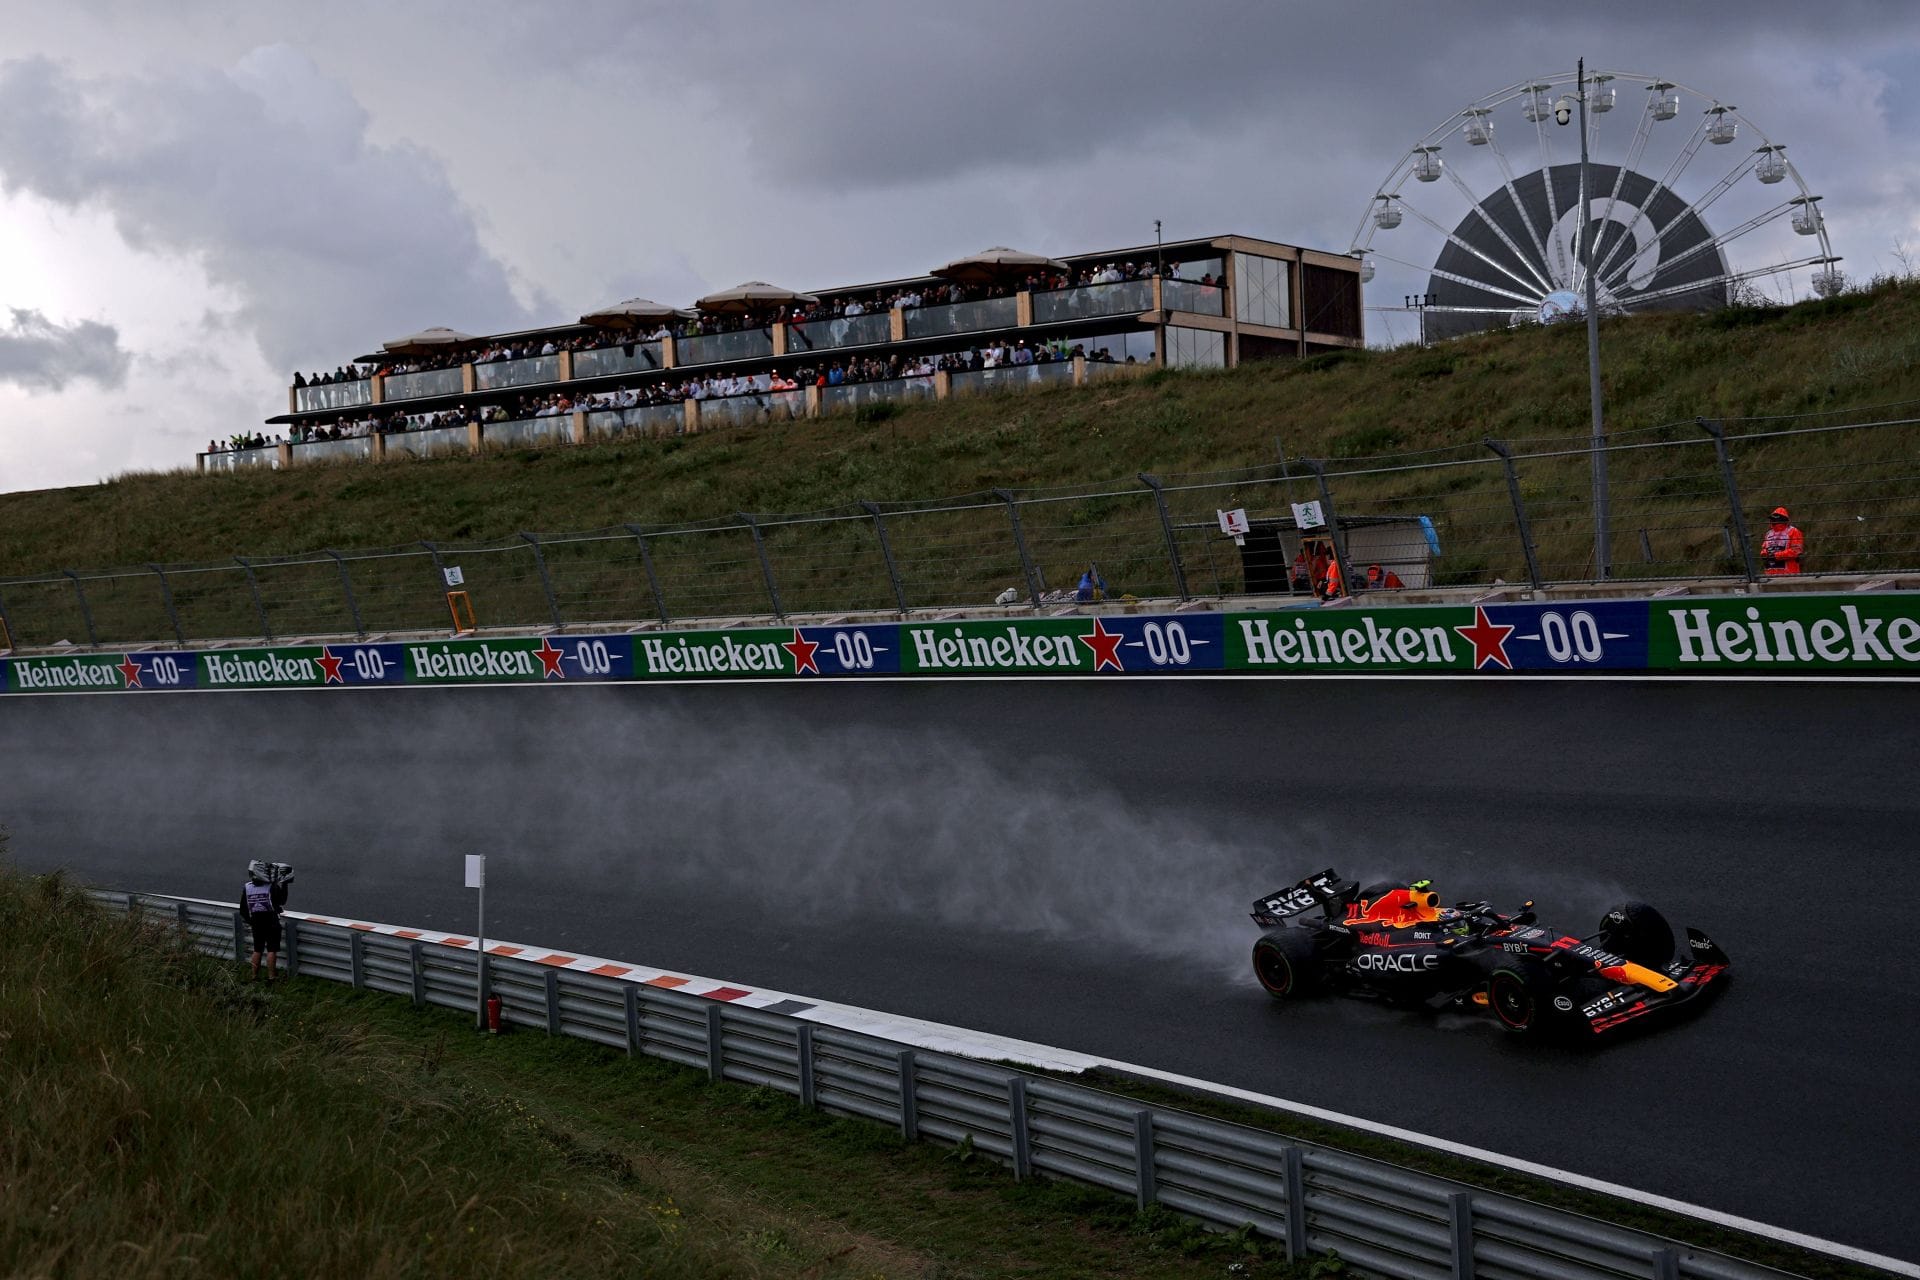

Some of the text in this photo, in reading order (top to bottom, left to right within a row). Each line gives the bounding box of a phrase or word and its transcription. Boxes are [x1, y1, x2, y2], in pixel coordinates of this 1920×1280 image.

[641, 636, 784, 673] Heineken
[910, 626, 1081, 668] Heineken
[1238, 617, 1456, 663] Heineken
[14, 660, 118, 688] Heineken
[204, 653, 317, 684] Heineken
[410, 645, 533, 678] Heineken
[1357, 953, 1440, 973] ORACLE
[1502, 941, 1528, 953] BYBIT
